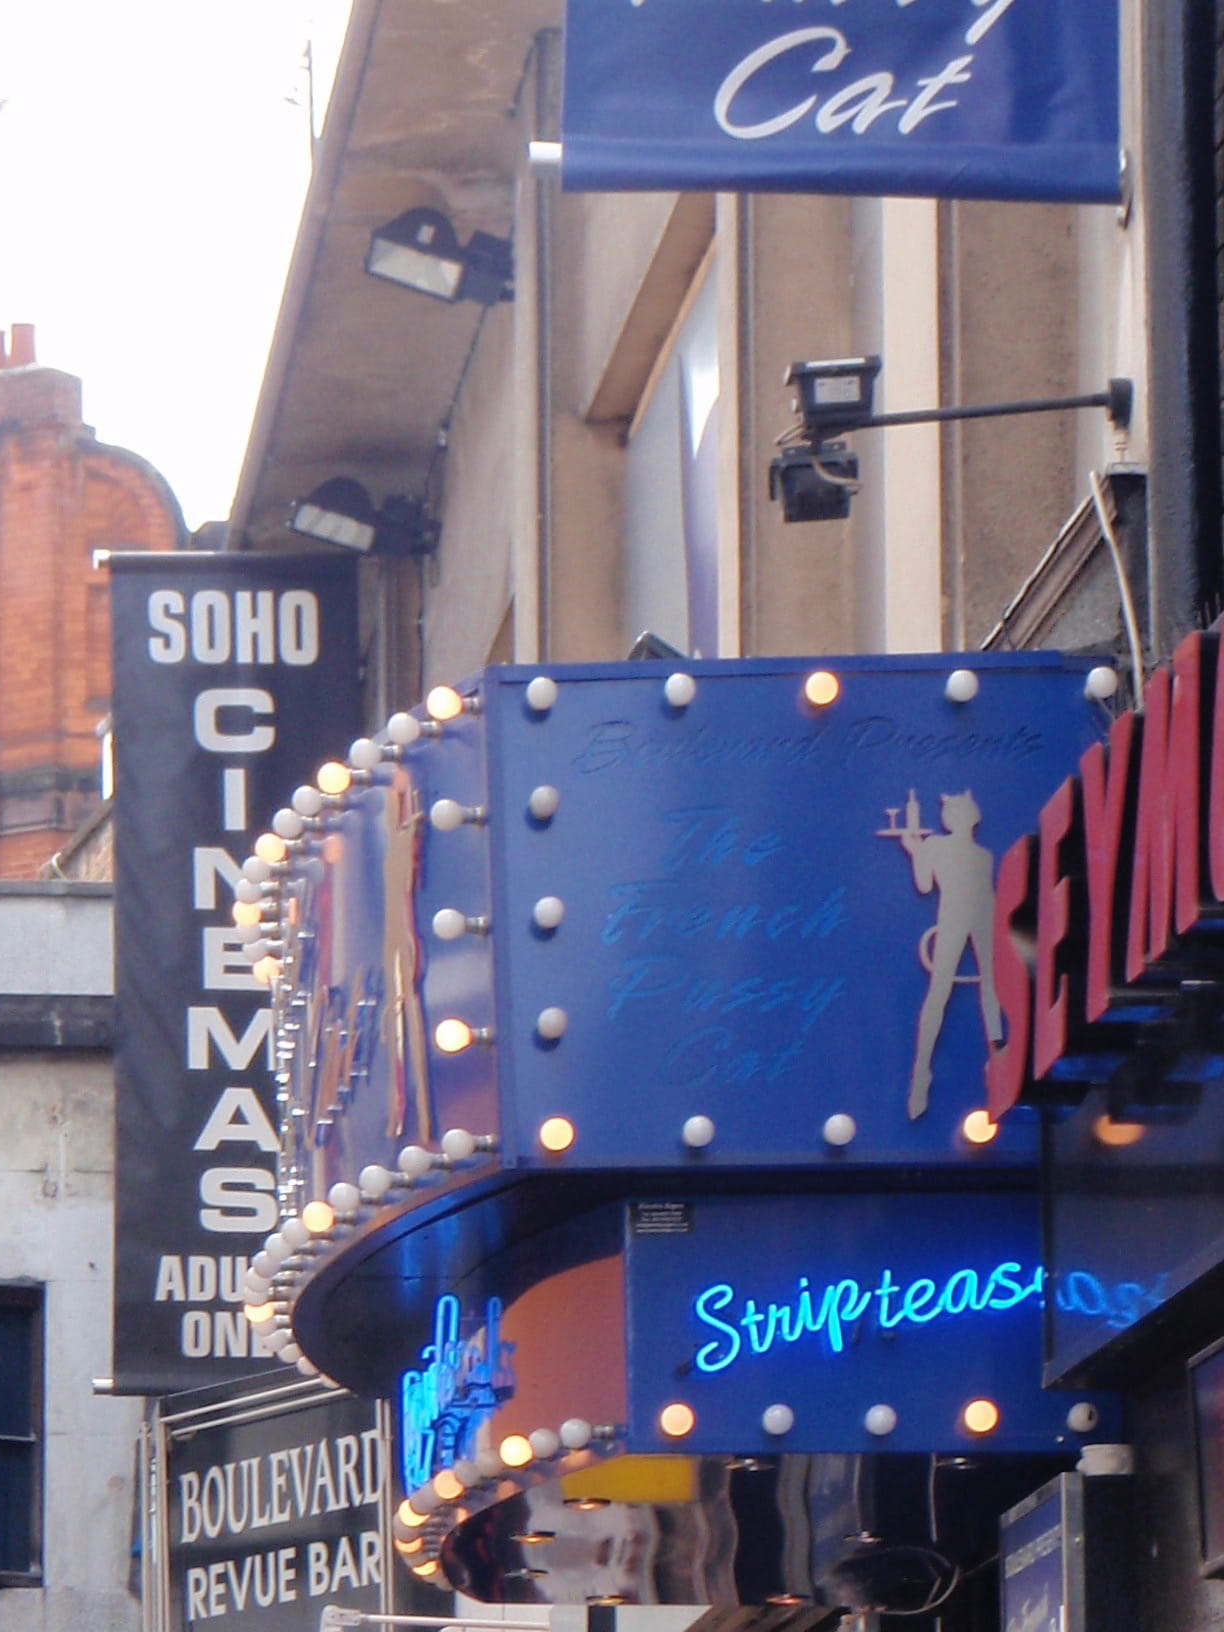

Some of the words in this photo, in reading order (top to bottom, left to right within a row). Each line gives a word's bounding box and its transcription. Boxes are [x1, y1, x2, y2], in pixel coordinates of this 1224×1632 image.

[713, 26, 974, 140] Cat
[148, 589, 319, 665] SOHO
[842, 715, 1045, 768] Presents
[656, 806, 784, 873] The
[987, 612, 1224, 1127] SEYM
[600, 878, 850, 947] French
[185, 688, 283, 1234] CINEMAS
[606, 953, 846, 1034] Pussy
[658, 1025, 808, 1088] Cat
[155, 1255, 250, 1303] ADU
[694, 1259, 1045, 1373] Stripteas
[180, 1429, 383, 1544] BOULEVARD
[187, 1545, 299, 1622] REVUE
[308, 1530, 384, 1595] BAR
